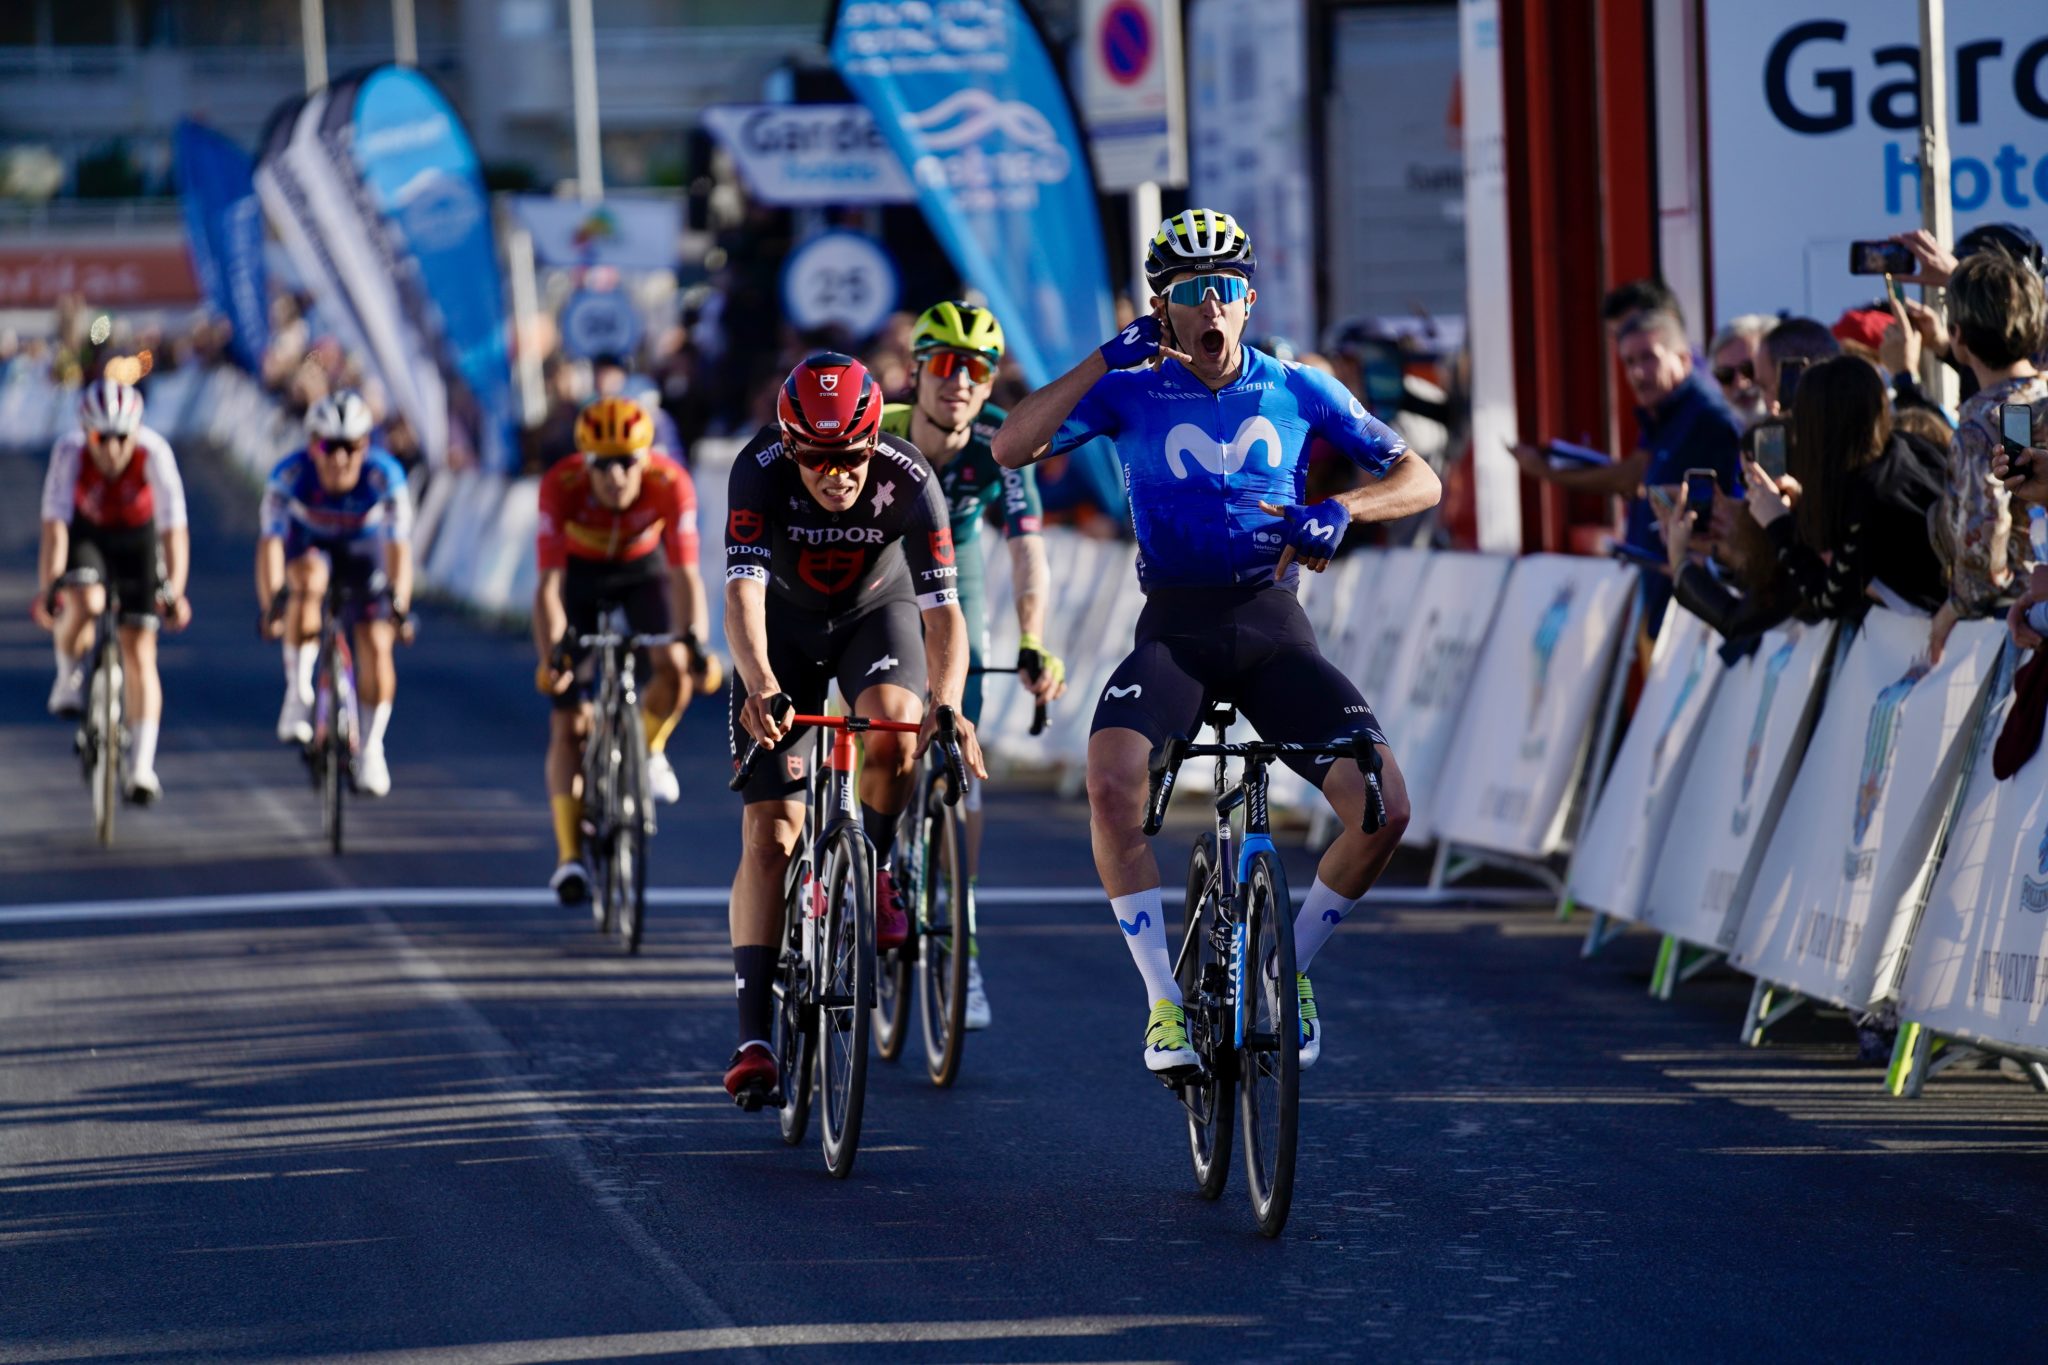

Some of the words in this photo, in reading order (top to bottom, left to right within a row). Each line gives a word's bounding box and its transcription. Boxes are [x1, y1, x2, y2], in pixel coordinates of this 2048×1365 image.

[755, 441, 784, 468] BM
[876, 442, 928, 483] BMC
[786, 526, 885, 545] TUDOR
[726, 567, 764, 579] BOSS
[921, 566, 958, 581] TUD
[935, 591, 958, 603] BO
[840, 776, 850, 812] BMC
[1250, 781, 1259, 826] CANYON
